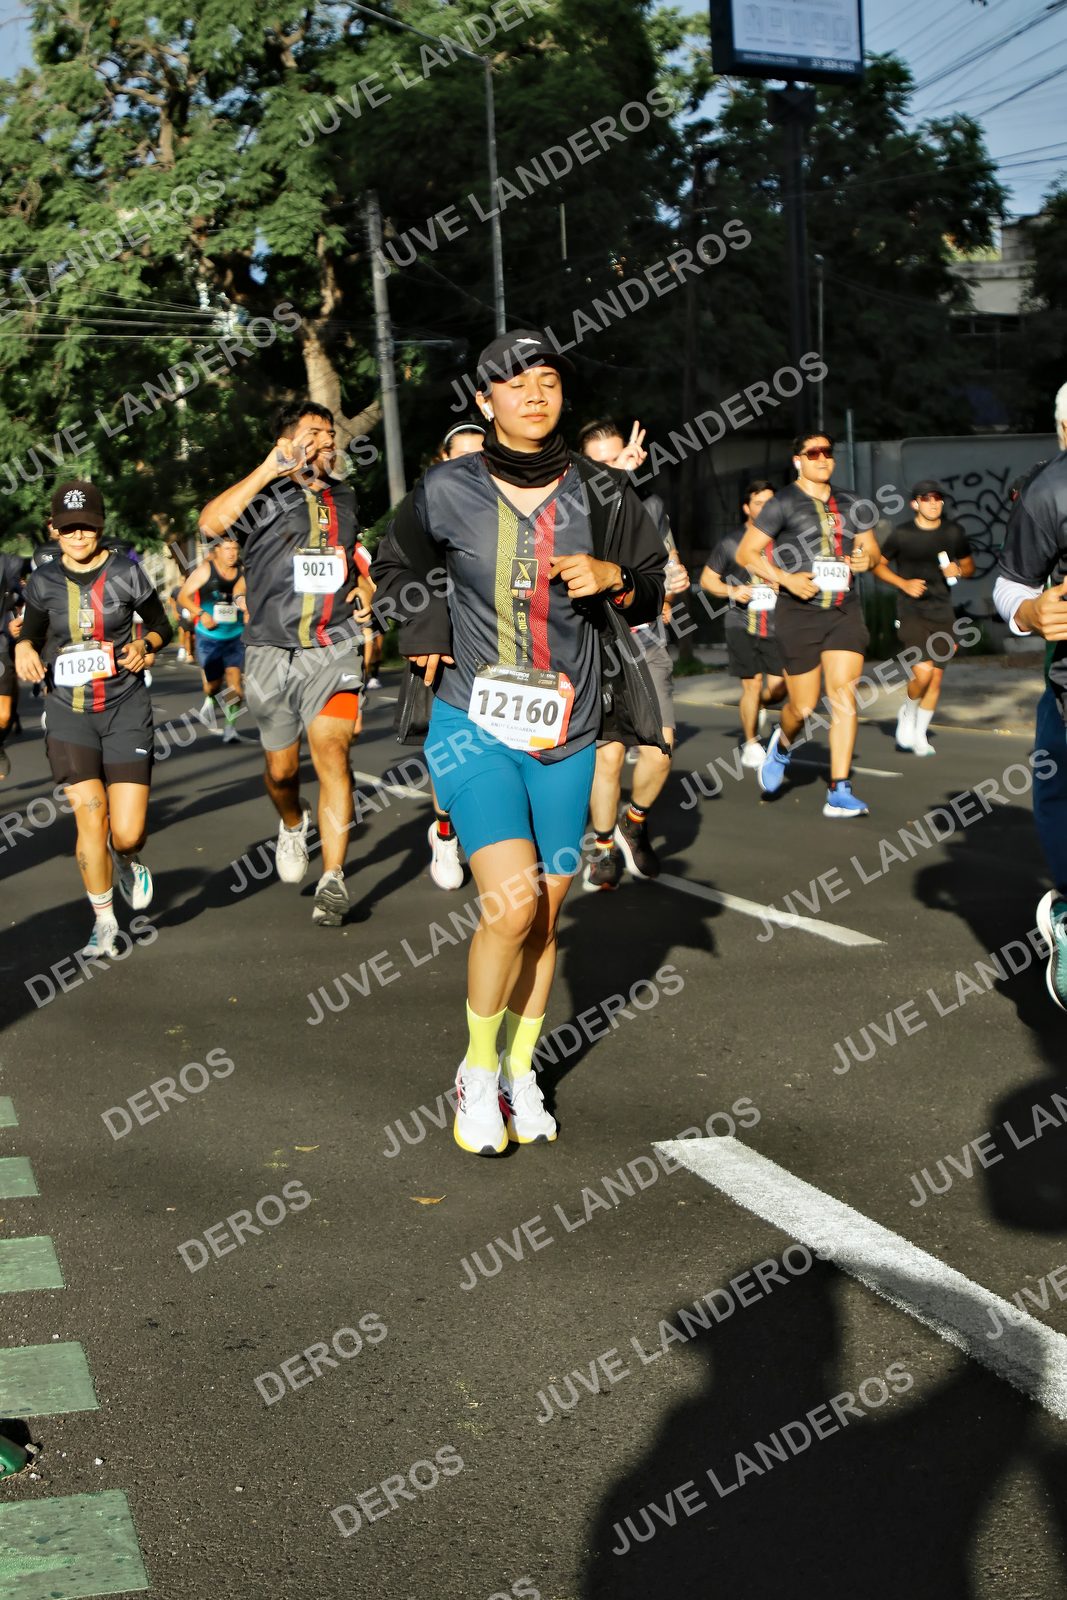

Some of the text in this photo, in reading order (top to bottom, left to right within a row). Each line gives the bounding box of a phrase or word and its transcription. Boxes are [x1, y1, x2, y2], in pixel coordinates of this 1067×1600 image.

[940, 467, 1010, 494] TOY
[303, 562, 333, 576] 9021
[816, 565, 848, 578] 10426
[59, 656, 105, 676] 11828
[478, 689, 559, 726] 12160
